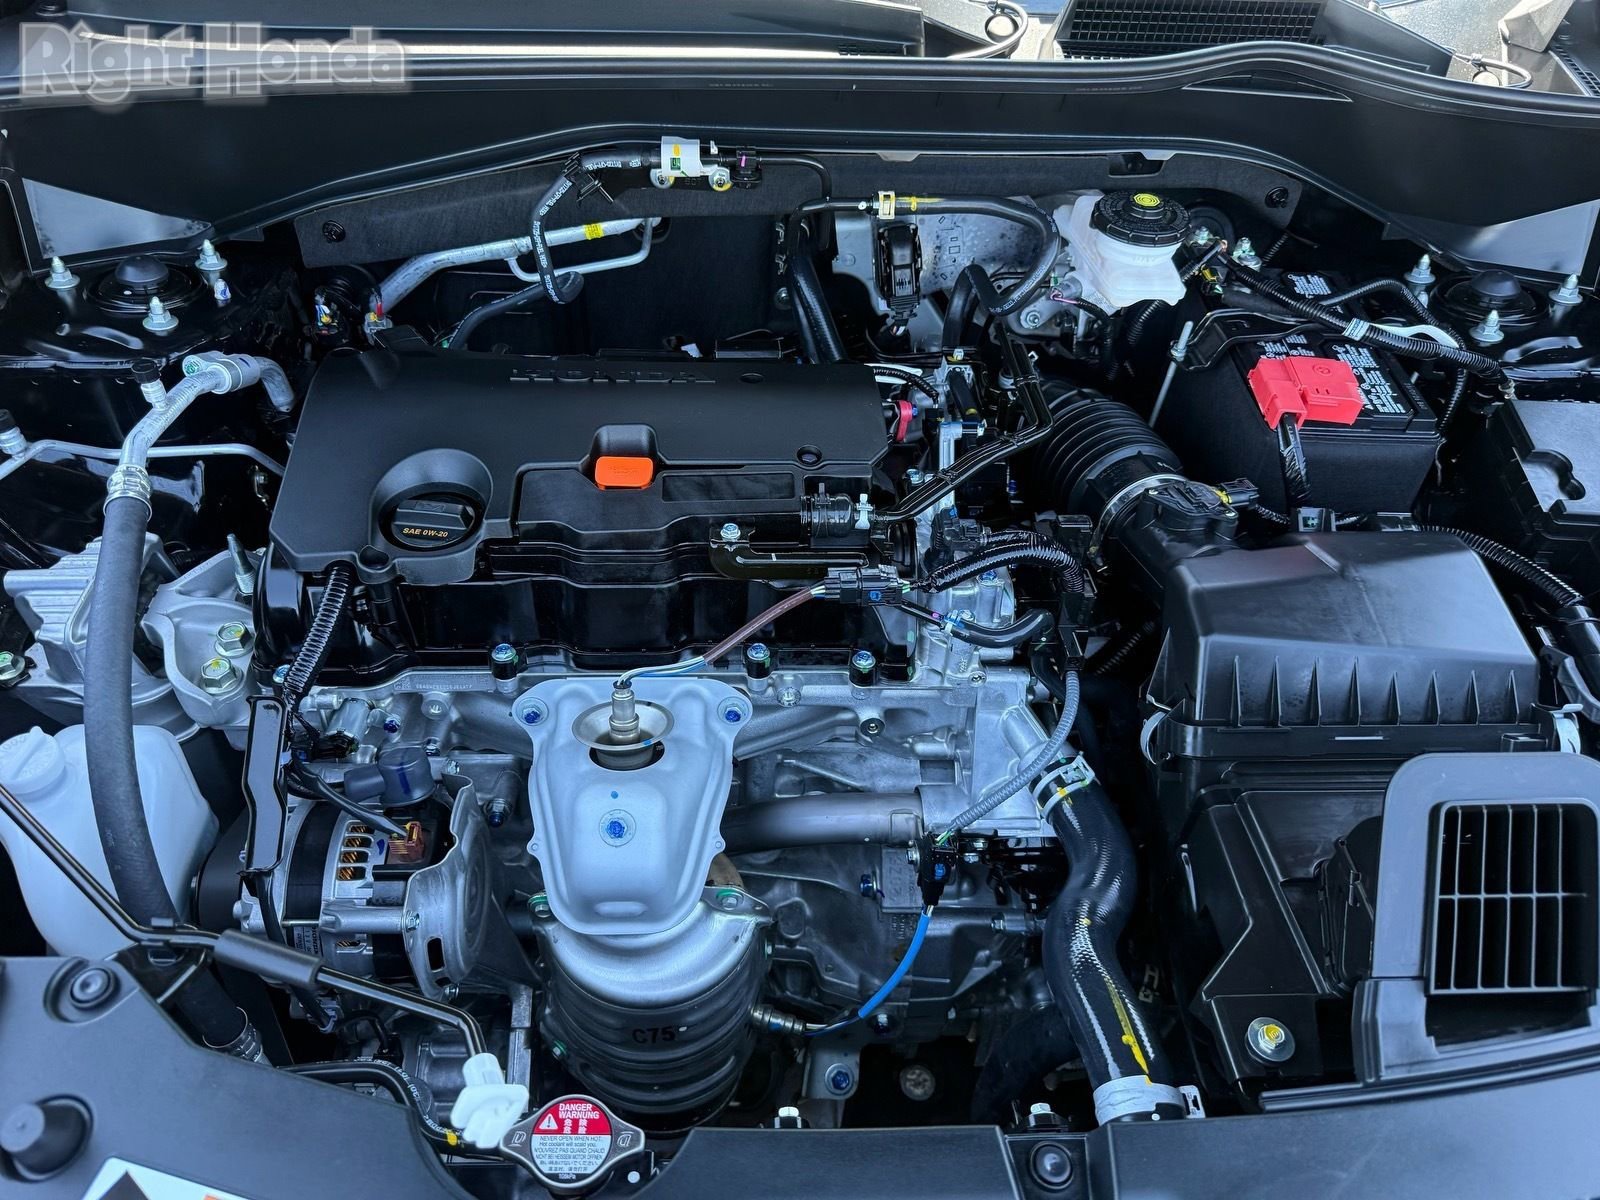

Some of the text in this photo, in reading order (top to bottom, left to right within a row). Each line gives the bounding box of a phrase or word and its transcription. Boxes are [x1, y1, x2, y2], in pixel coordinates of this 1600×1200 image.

[402, 527, 449, 538] SAE 0W-20
[631, 1026, 676, 1044] C75
[559, 1103, 593, 1111] DANGER
[558, 1111, 600, 1119] WARNUNG
